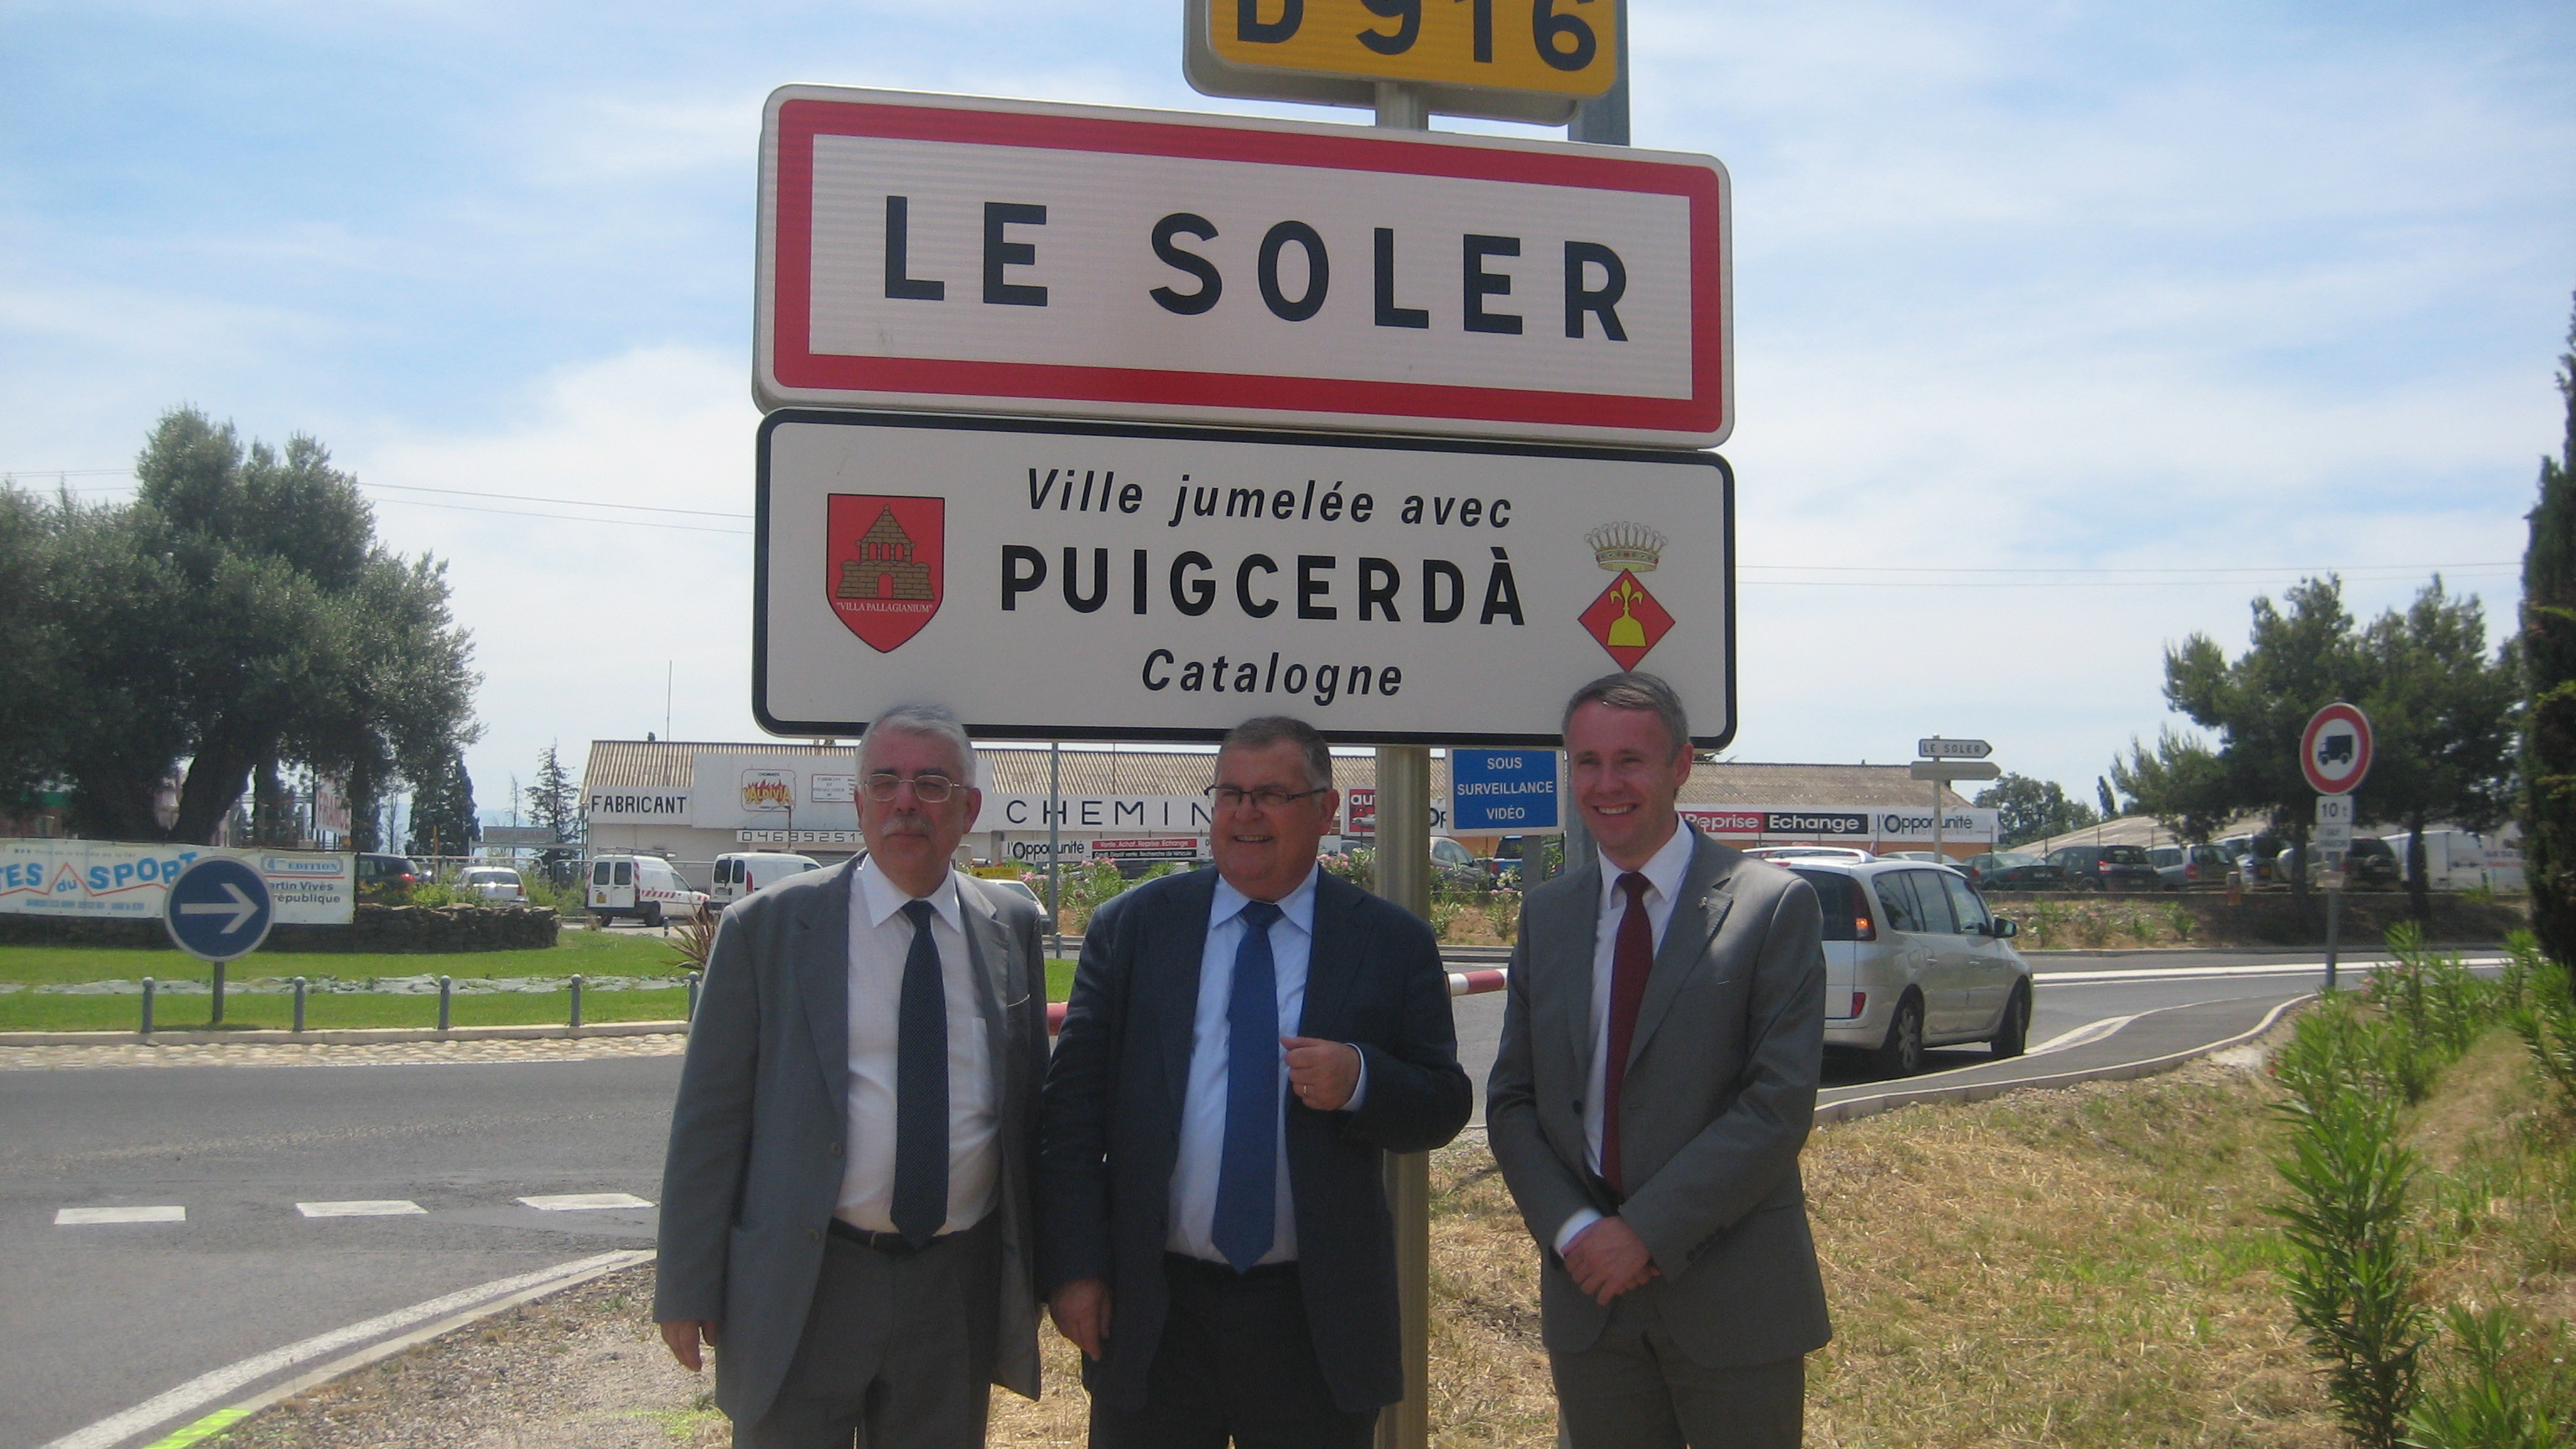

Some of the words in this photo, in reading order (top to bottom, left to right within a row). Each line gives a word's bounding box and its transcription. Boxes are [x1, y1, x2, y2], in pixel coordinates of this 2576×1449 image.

[1356, 0, 1596, 71] 916
[886, 195, 1048, 307] LE
[1149, 212, 1628, 342] SOLER
[1028, 468, 1143, 513] Ville
[1167, 474, 1374, 527] jumelée
[1400, 495, 1512, 528] avec
[1001, 545, 1525, 626] PUIGCERDÀ
[1142, 648, 1402, 707] Catalogne
[1924, 744, 1936, 753] LE
[1944, 744, 1981, 754] SOLER
[1487, 756, 1523, 770] SOUS
[1457, 781, 1554, 796] SURVEILLANCE
[591, 795, 687, 814] FABRICANT
[1486, 805, 1525, 820] VIDÉO
[2321, 802, 2337, 817] 10
[1685, 813, 1759, 831] Reprise
[1768, 814, 1859, 833] Echange
[1877, 814, 1972, 834] l'Opporunité
[1007, 840, 1084, 860] l'Oppounité
[56, 880, 78, 892] du
[270, 881, 297, 891] artin
